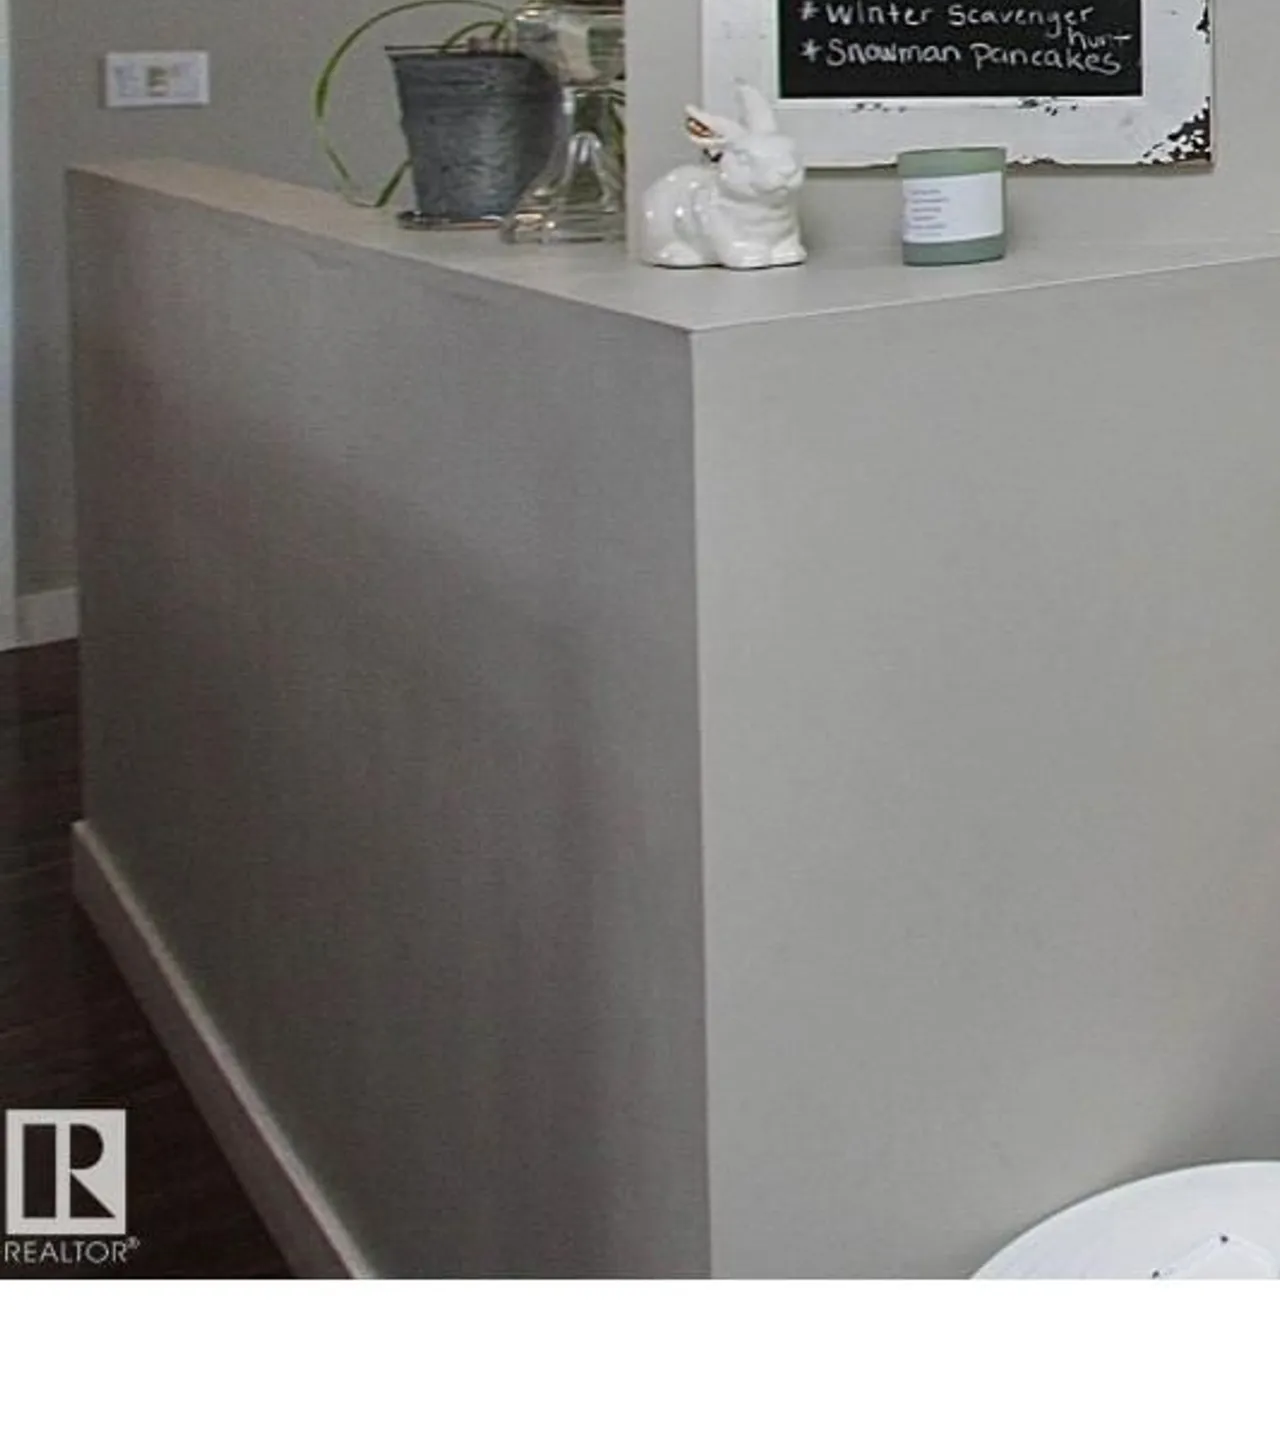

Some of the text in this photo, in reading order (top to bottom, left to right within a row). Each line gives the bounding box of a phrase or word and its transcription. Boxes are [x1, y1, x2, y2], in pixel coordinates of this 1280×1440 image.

[826, 3, 933, 26] Winter
[826, 38, 962, 66] Snowman
[1067, 27, 1133, 52] hunt
